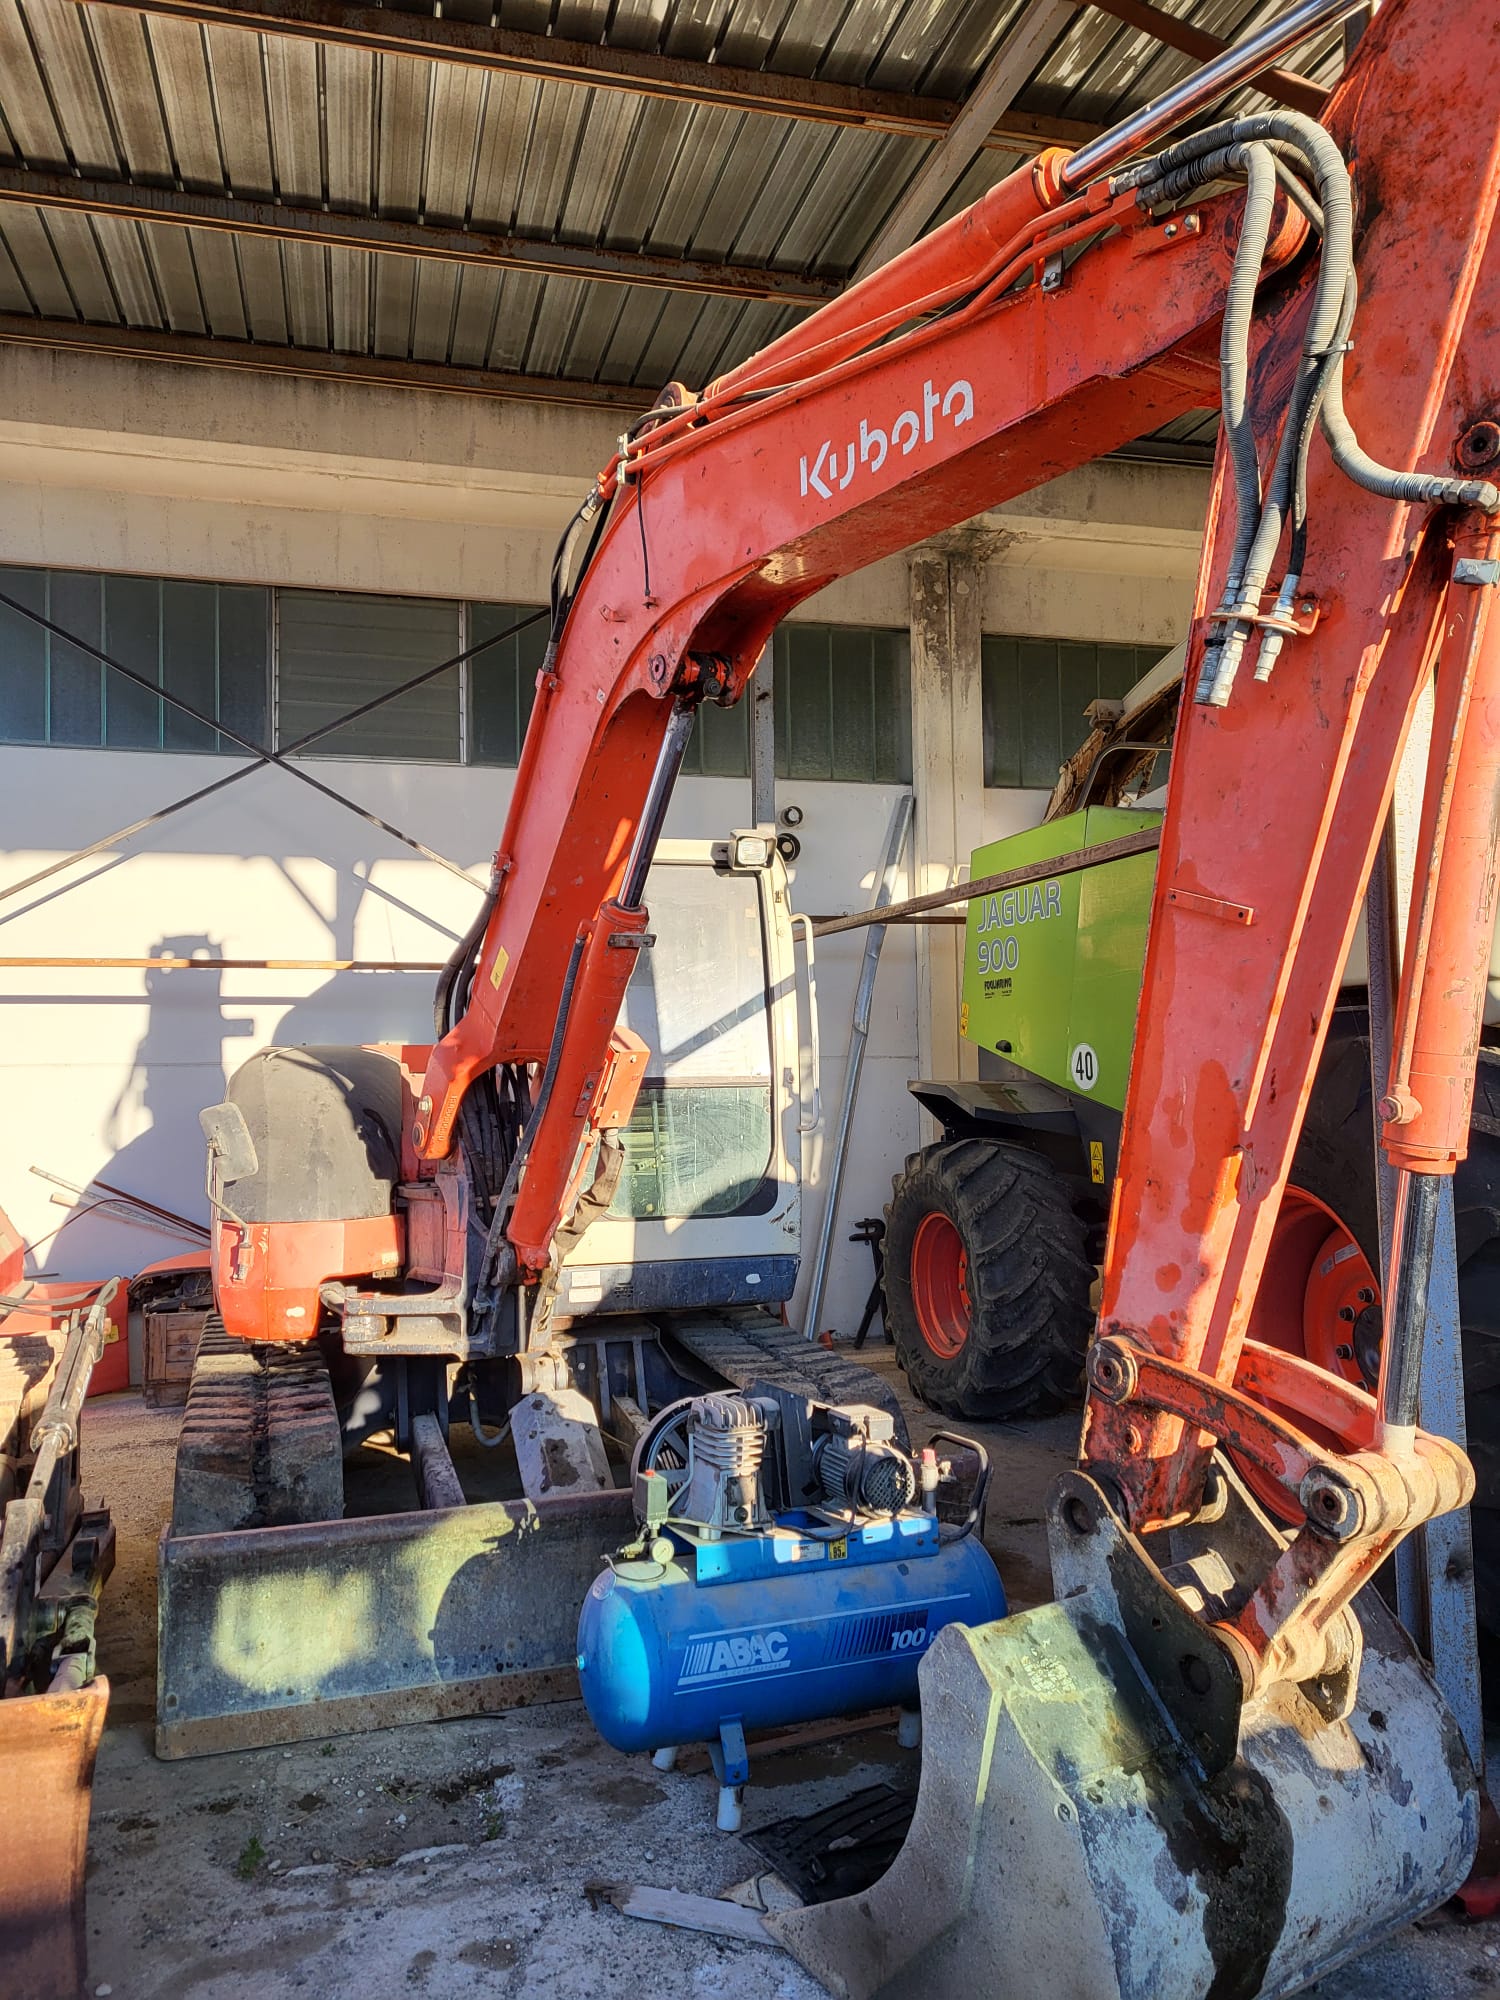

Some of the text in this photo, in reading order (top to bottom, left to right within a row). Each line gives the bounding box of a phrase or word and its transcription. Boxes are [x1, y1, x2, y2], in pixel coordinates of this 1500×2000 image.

[800, 379, 973, 499] Kubota
[977, 880, 1061, 933] JAGUAR
[978, 935, 1019, 974] 900
[1076, 1051, 1093, 1081] 40
[709, 1631, 789, 1671] ABAC
[891, 1628, 926, 1651] 100
